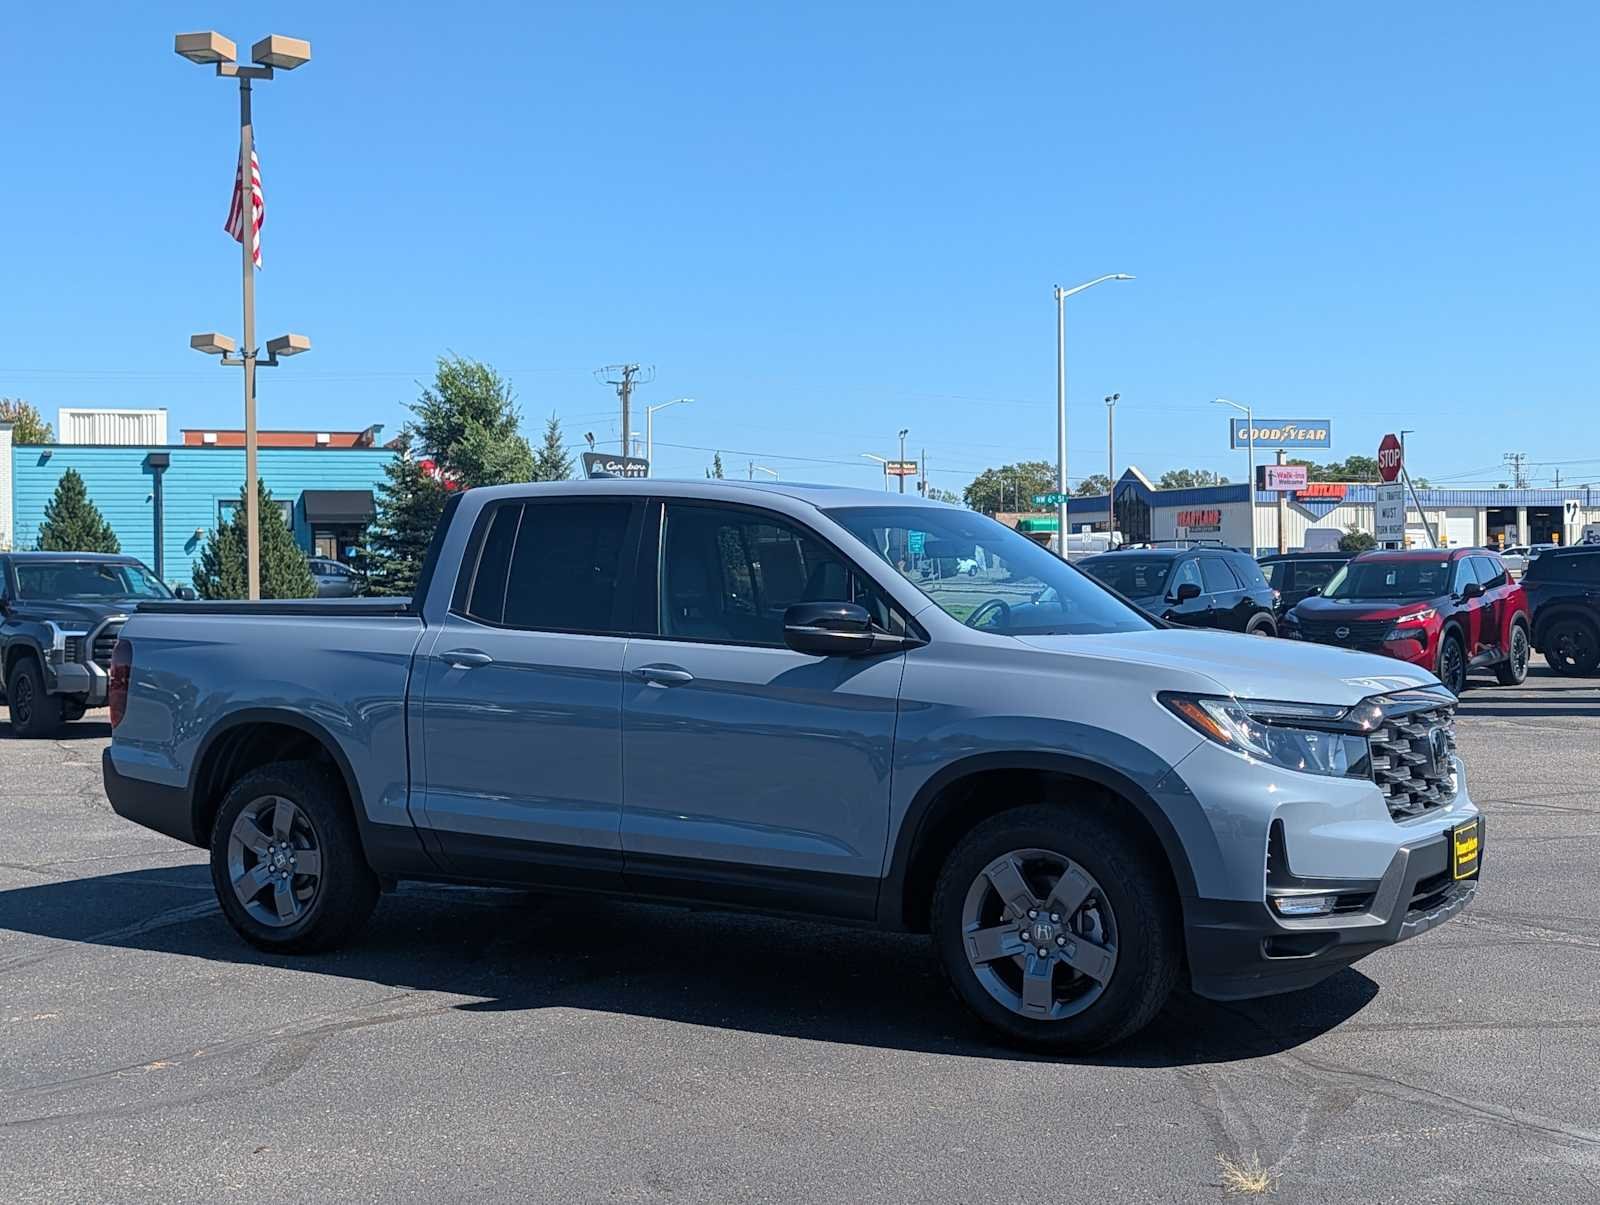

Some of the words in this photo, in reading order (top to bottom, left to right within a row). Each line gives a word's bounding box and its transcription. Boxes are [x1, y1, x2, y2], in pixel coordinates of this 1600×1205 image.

[1238, 427, 1326, 441] GOODYEAR
[1379, 448, 1400, 469] STOP
[1035, 495, 1046, 504] NW
[1382, 507, 1397, 519] MUST
